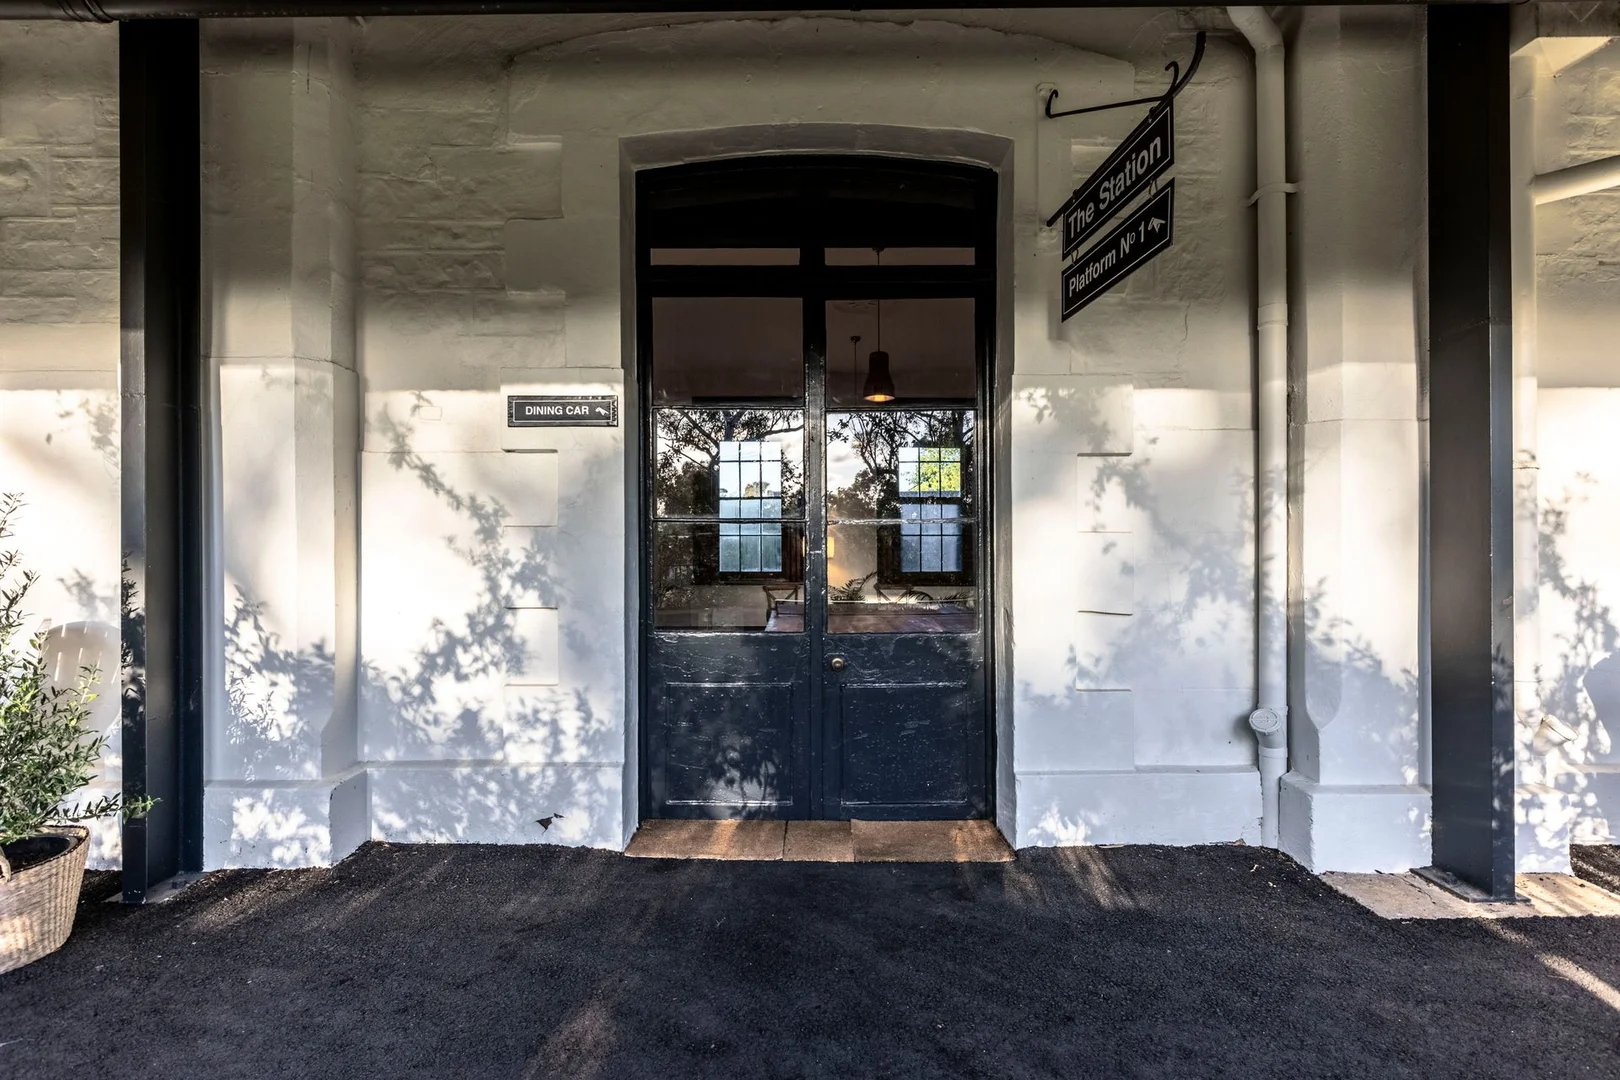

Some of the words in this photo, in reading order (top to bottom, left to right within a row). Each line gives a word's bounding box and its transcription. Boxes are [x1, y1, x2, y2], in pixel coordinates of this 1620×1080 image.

[1068, 202, 1095, 239] The
[1099, 136, 1161, 210] Station
[1069, 249, 1116, 297] Platform
[525, 406, 563, 415] DINING
[565, 405, 589, 415] CAR
